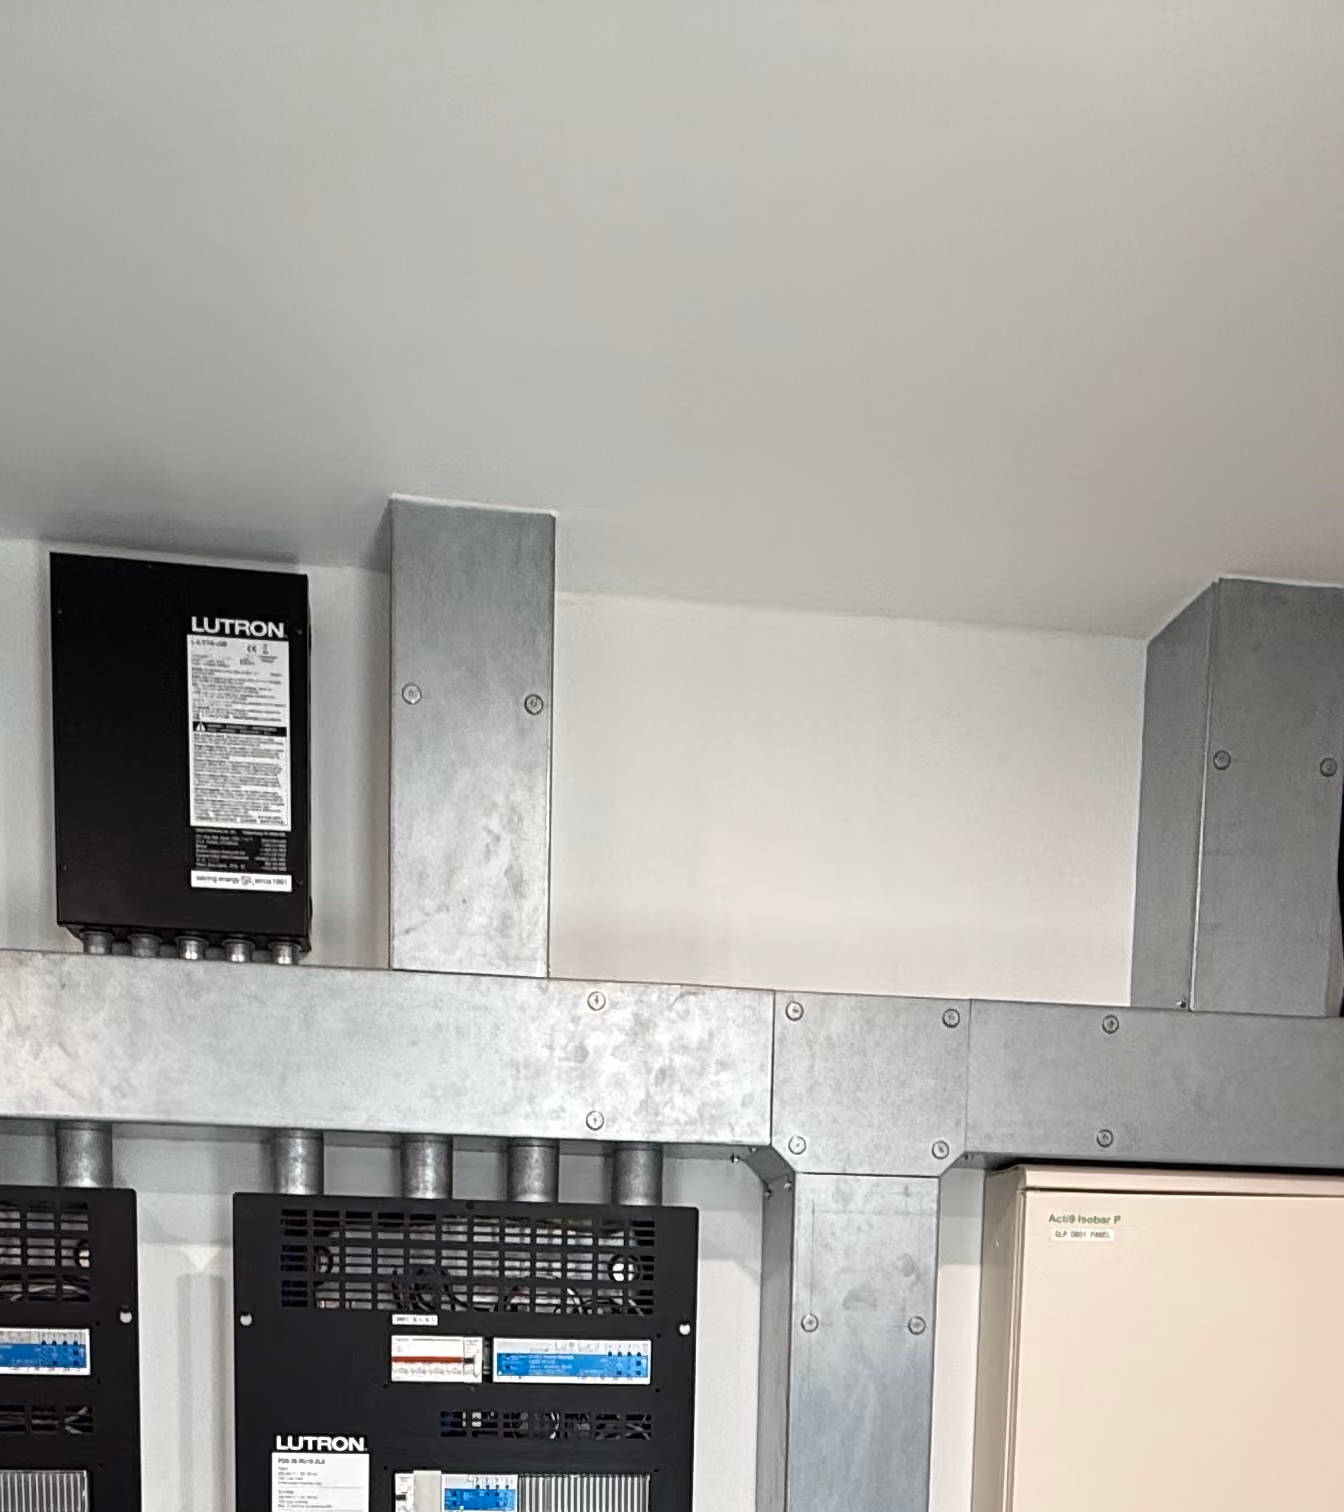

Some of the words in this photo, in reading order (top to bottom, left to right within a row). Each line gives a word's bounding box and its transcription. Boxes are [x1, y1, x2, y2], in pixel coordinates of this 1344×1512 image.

[191, 616, 284, 638] LUTRON
[1077, 1214, 1111, 1224] Isobar
[1113, 1215, 1122, 1225] P
[276, 1435, 364, 1452] LUTRON
